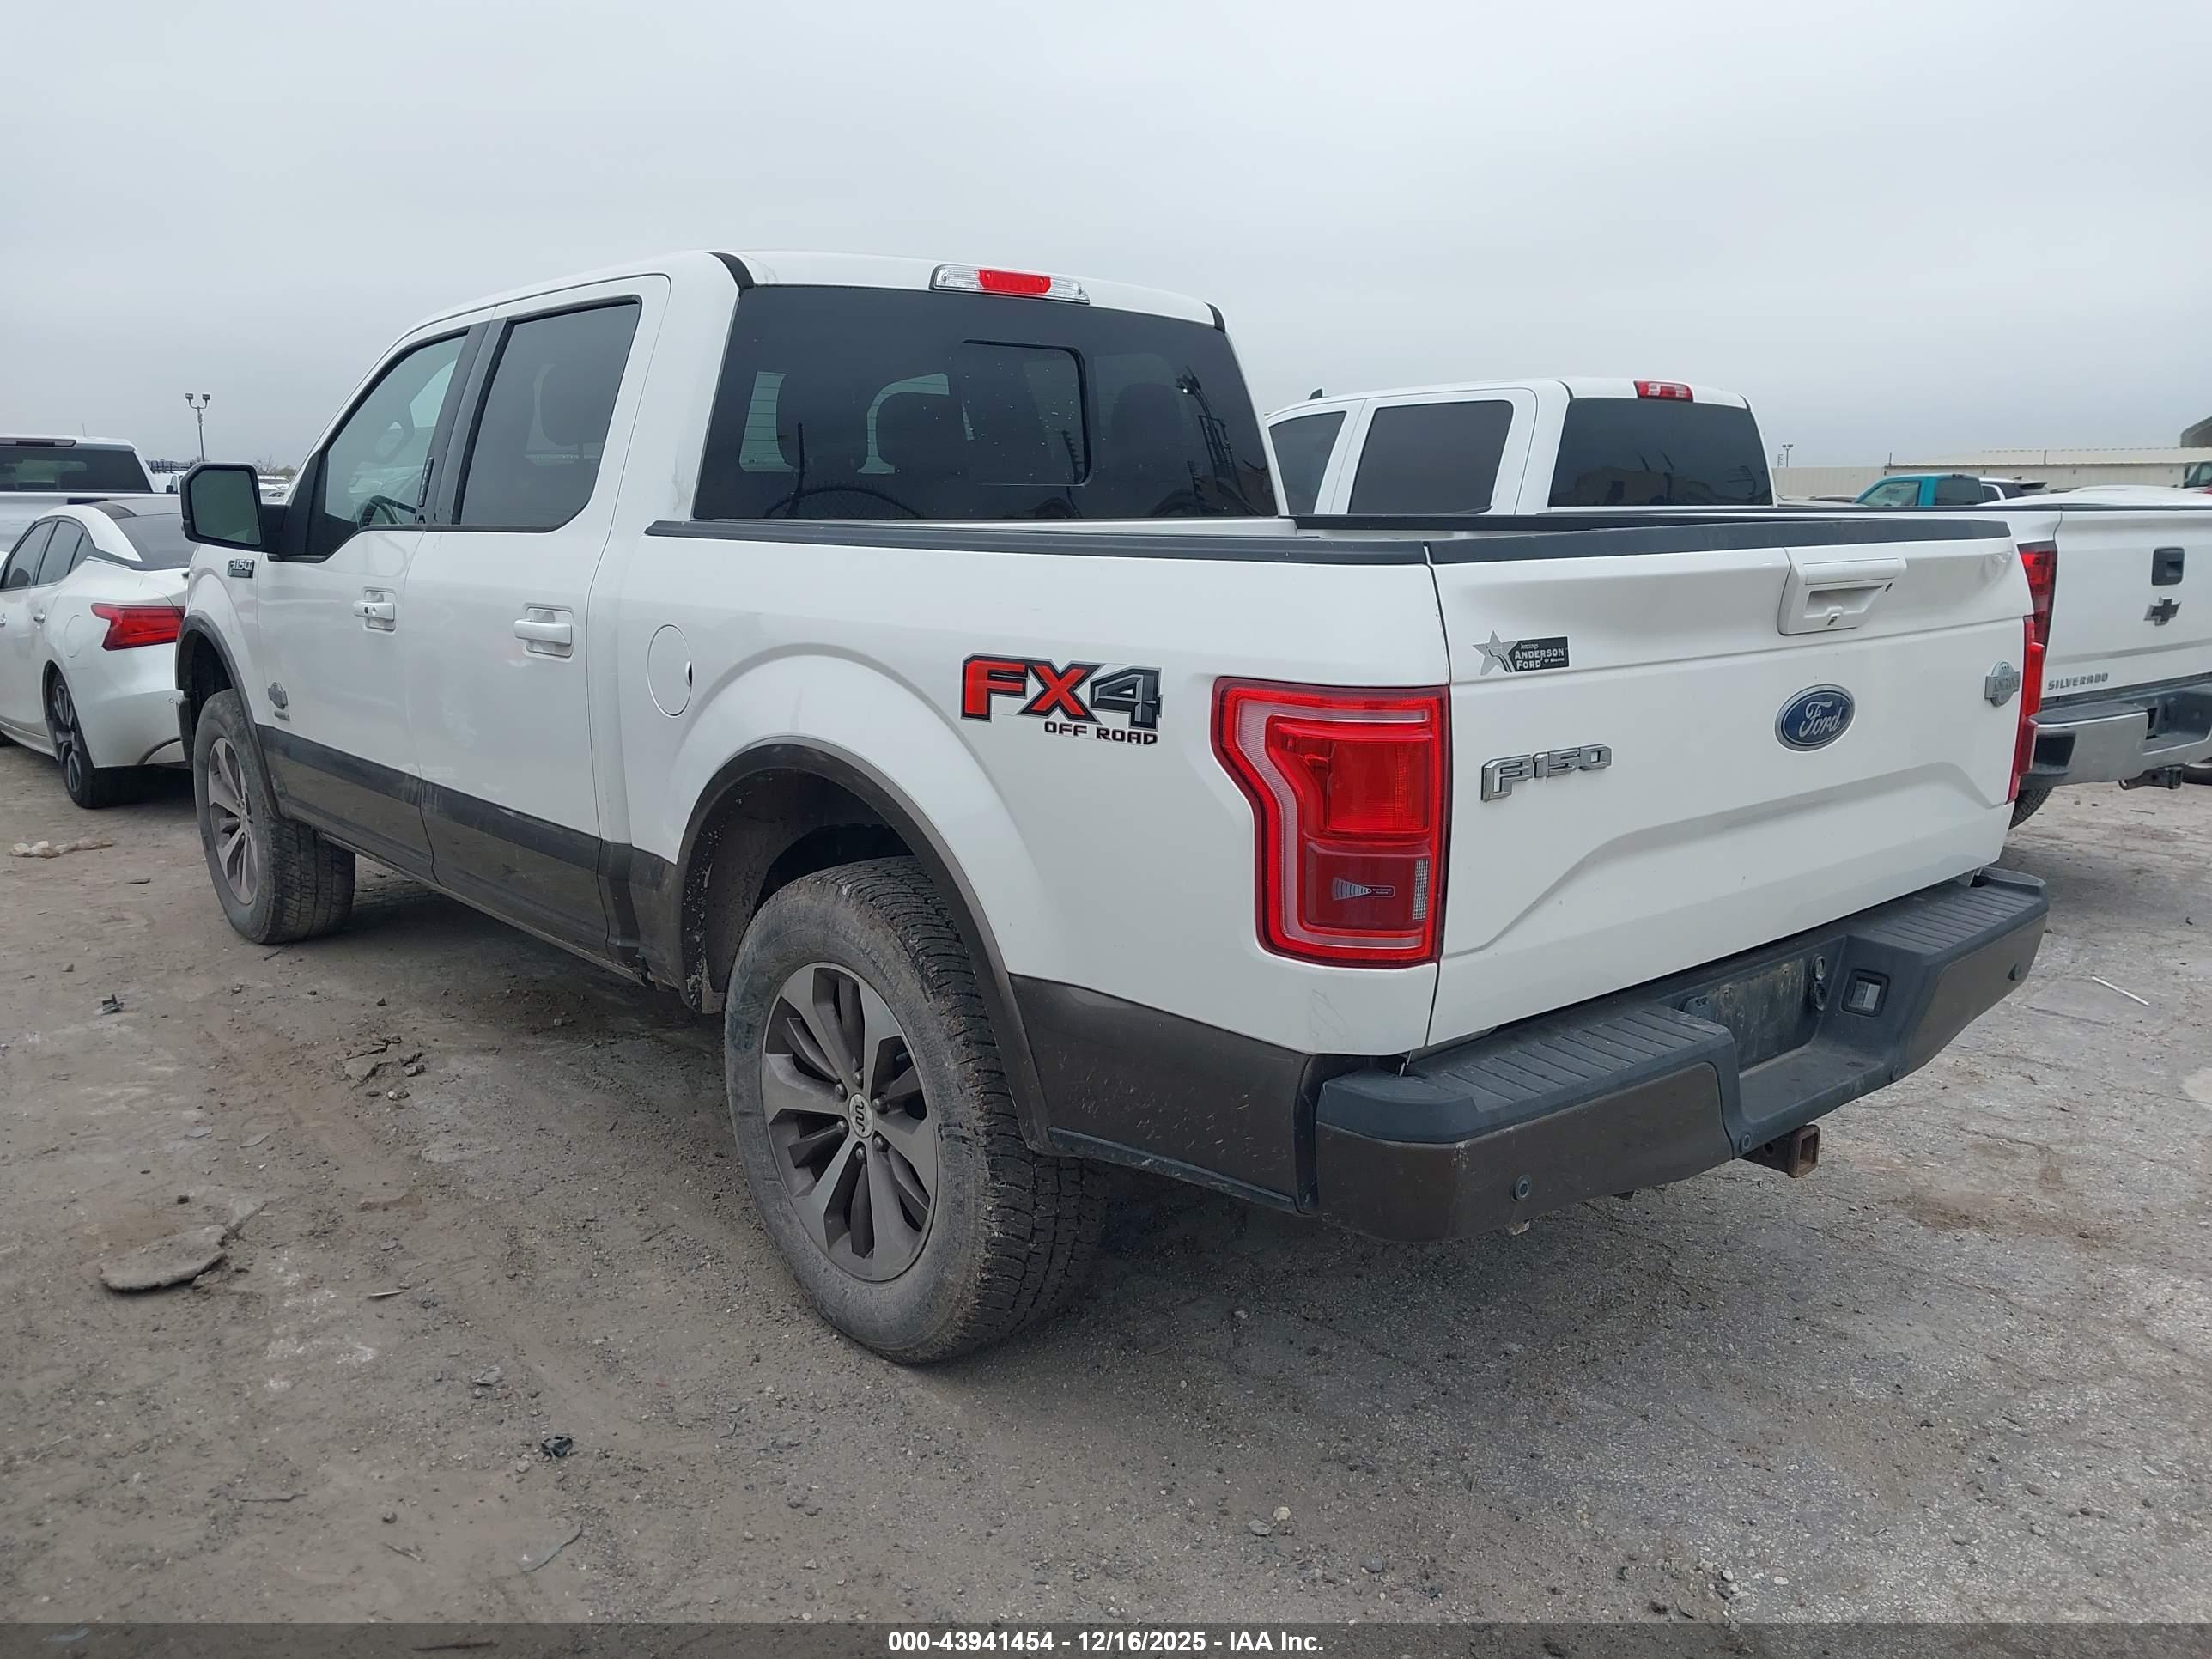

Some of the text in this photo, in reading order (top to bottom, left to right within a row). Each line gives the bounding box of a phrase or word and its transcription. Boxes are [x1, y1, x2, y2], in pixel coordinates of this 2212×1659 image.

[1514, 647, 1565, 660] ANDERSON
[1516, 659, 1541, 670] FORD
[961, 653, 1164, 732] FX4
[2047, 672, 2109, 690] SILVERADO
[1799, 700, 1843, 738] Ford
[1044, 721, 1158, 745] OFF ROAD
[1480, 743, 1613, 803] F150
